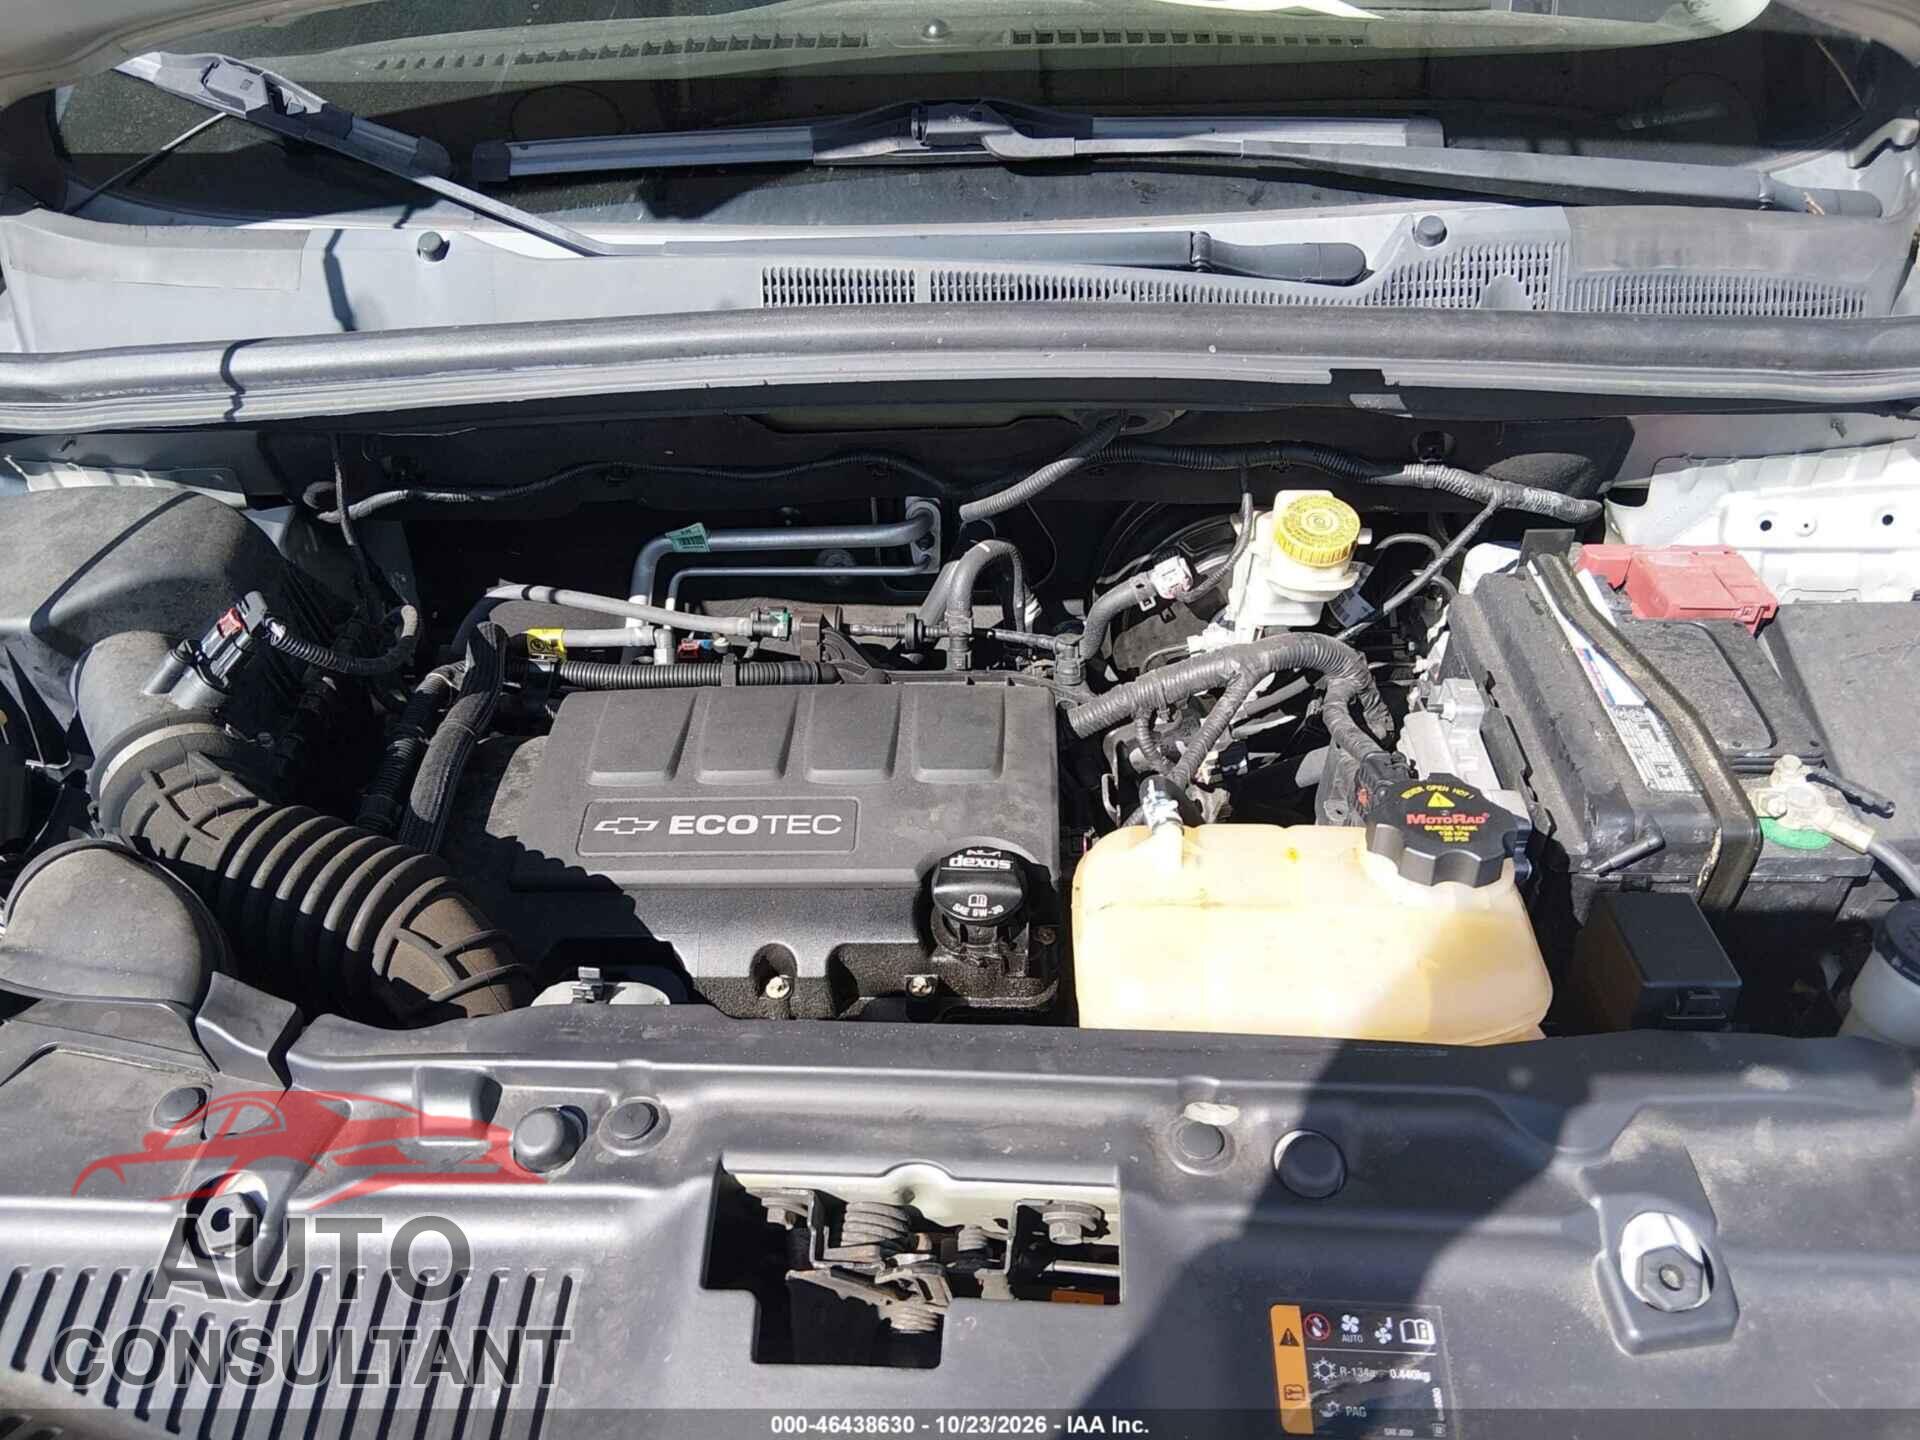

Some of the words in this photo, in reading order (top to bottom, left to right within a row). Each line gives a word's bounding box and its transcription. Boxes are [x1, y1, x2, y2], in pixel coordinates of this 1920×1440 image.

[668, 814, 842, 835] ECOTEC
[949, 854, 1013, 869] dexos
[1341, 1334, 1364, 1343] AUTO
[1346, 1406, 1367, 1417] PAG
